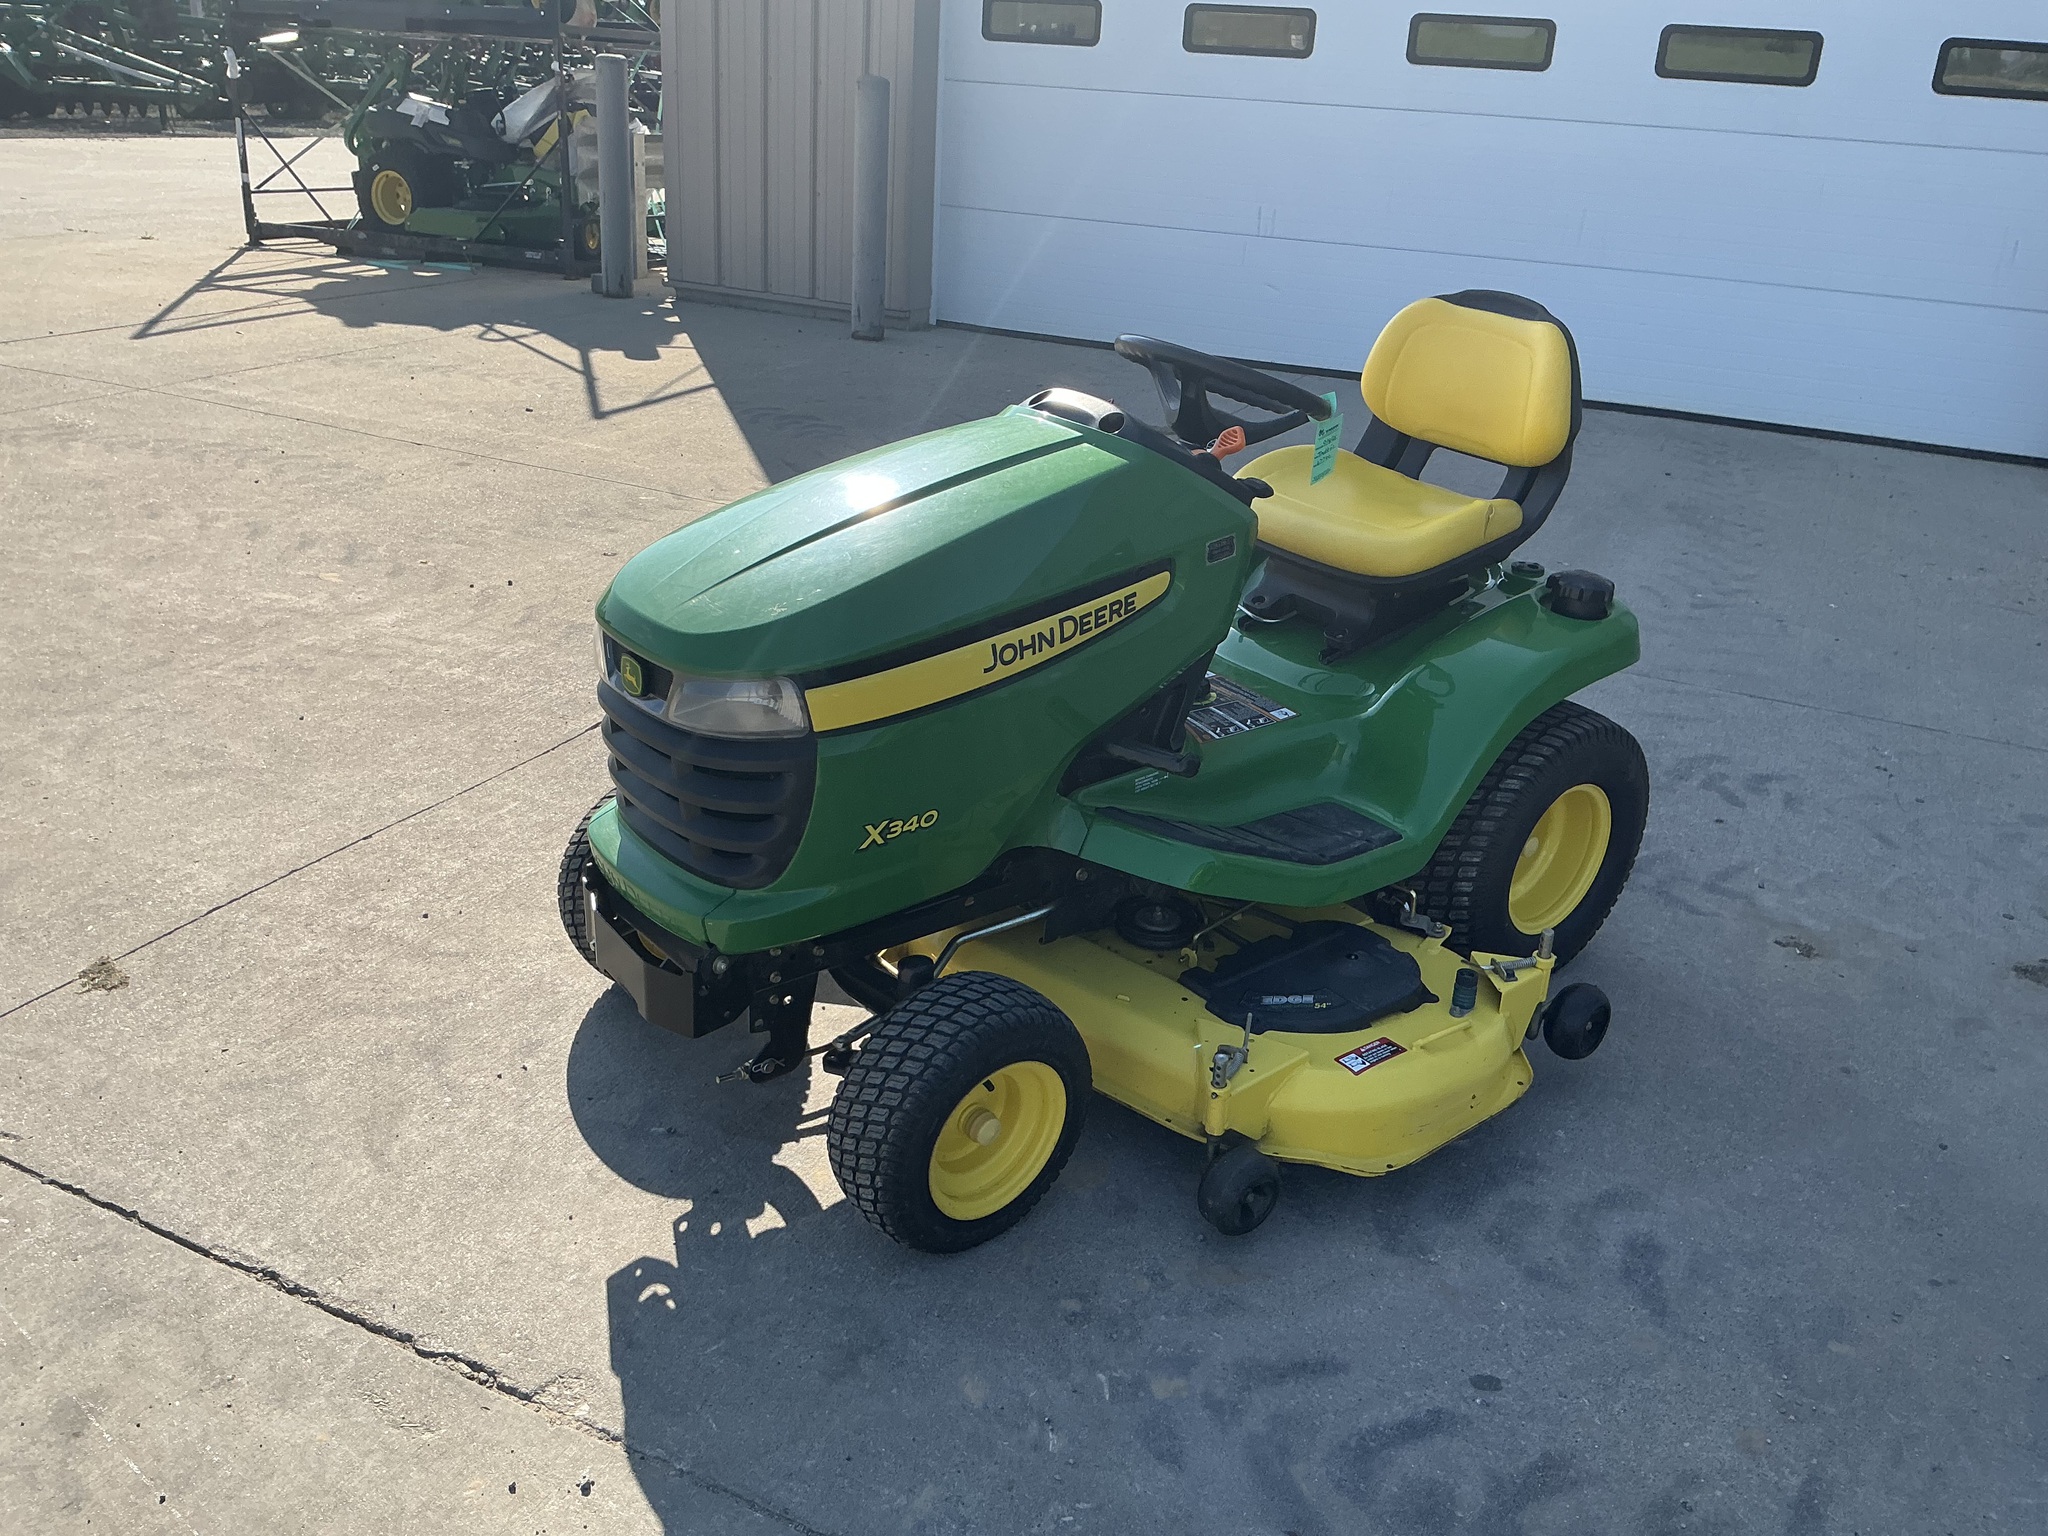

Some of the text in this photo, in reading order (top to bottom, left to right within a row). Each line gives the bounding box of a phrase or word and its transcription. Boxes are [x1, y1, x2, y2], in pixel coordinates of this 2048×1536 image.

[983, 591, 1137, 674] JOHN DEERE
[858, 808, 940, 850] X340
[1261, 995, 1314, 1005] EDGE
